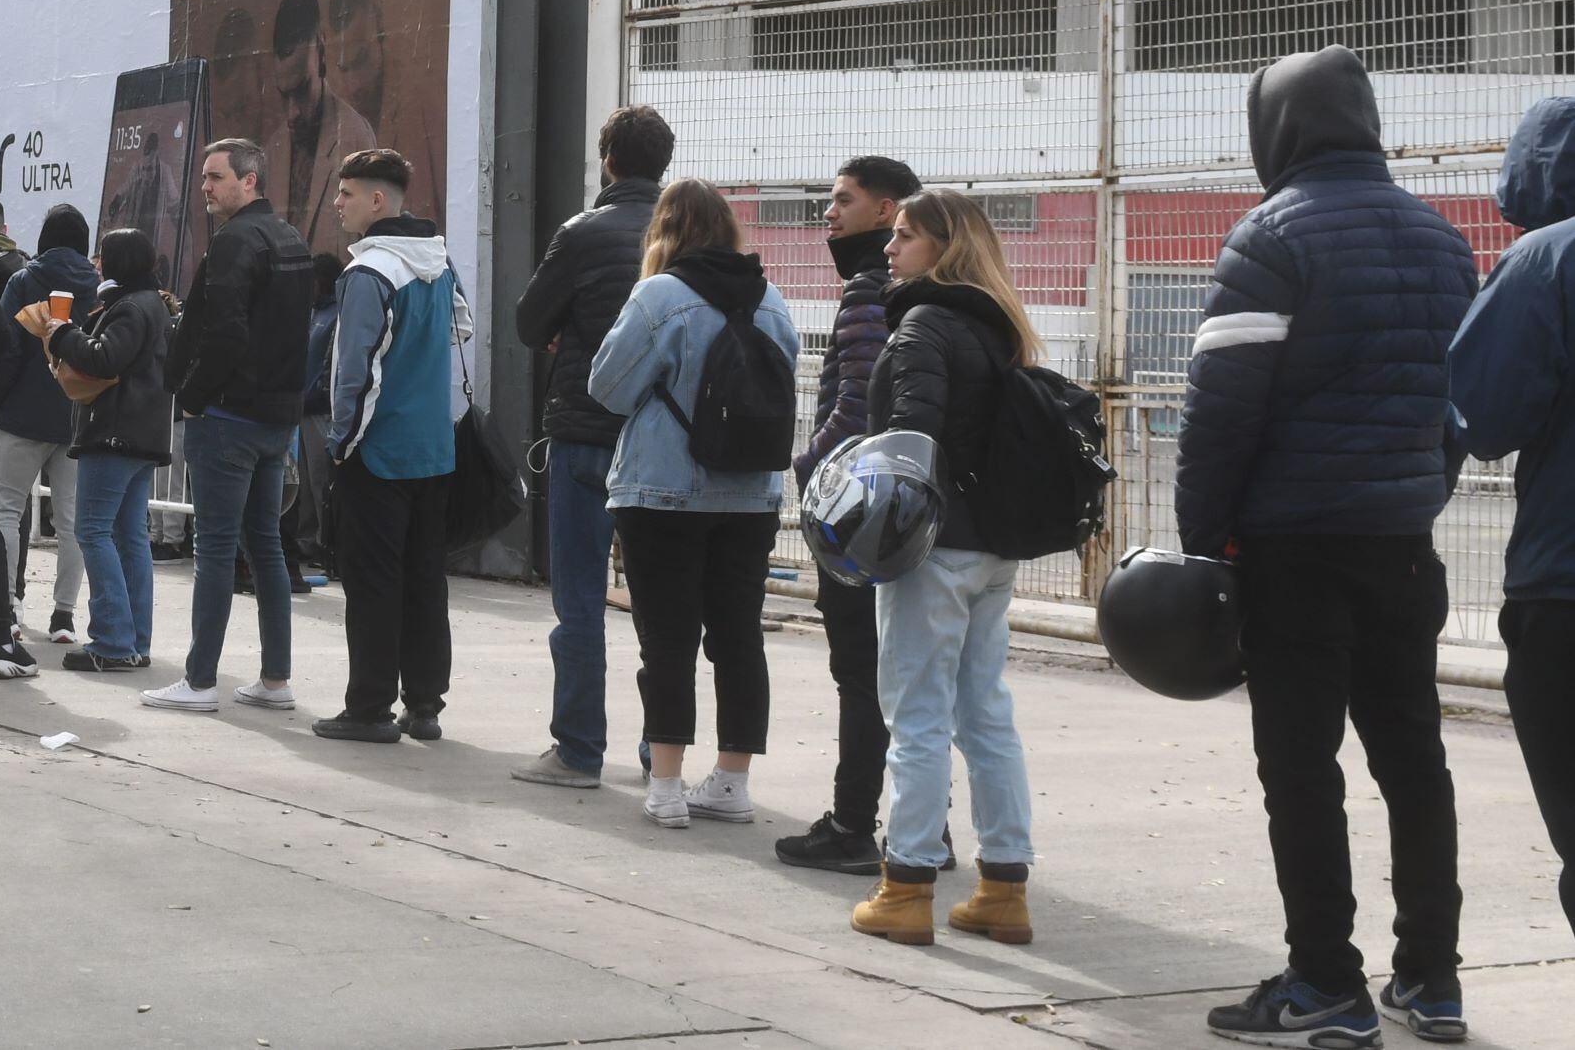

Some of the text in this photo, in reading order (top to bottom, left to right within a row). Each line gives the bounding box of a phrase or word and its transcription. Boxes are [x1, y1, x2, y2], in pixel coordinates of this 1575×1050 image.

[22, 130, 44, 158] 40
[115, 125, 142, 151] 11:35
[22, 161, 73, 193] ULTRA
